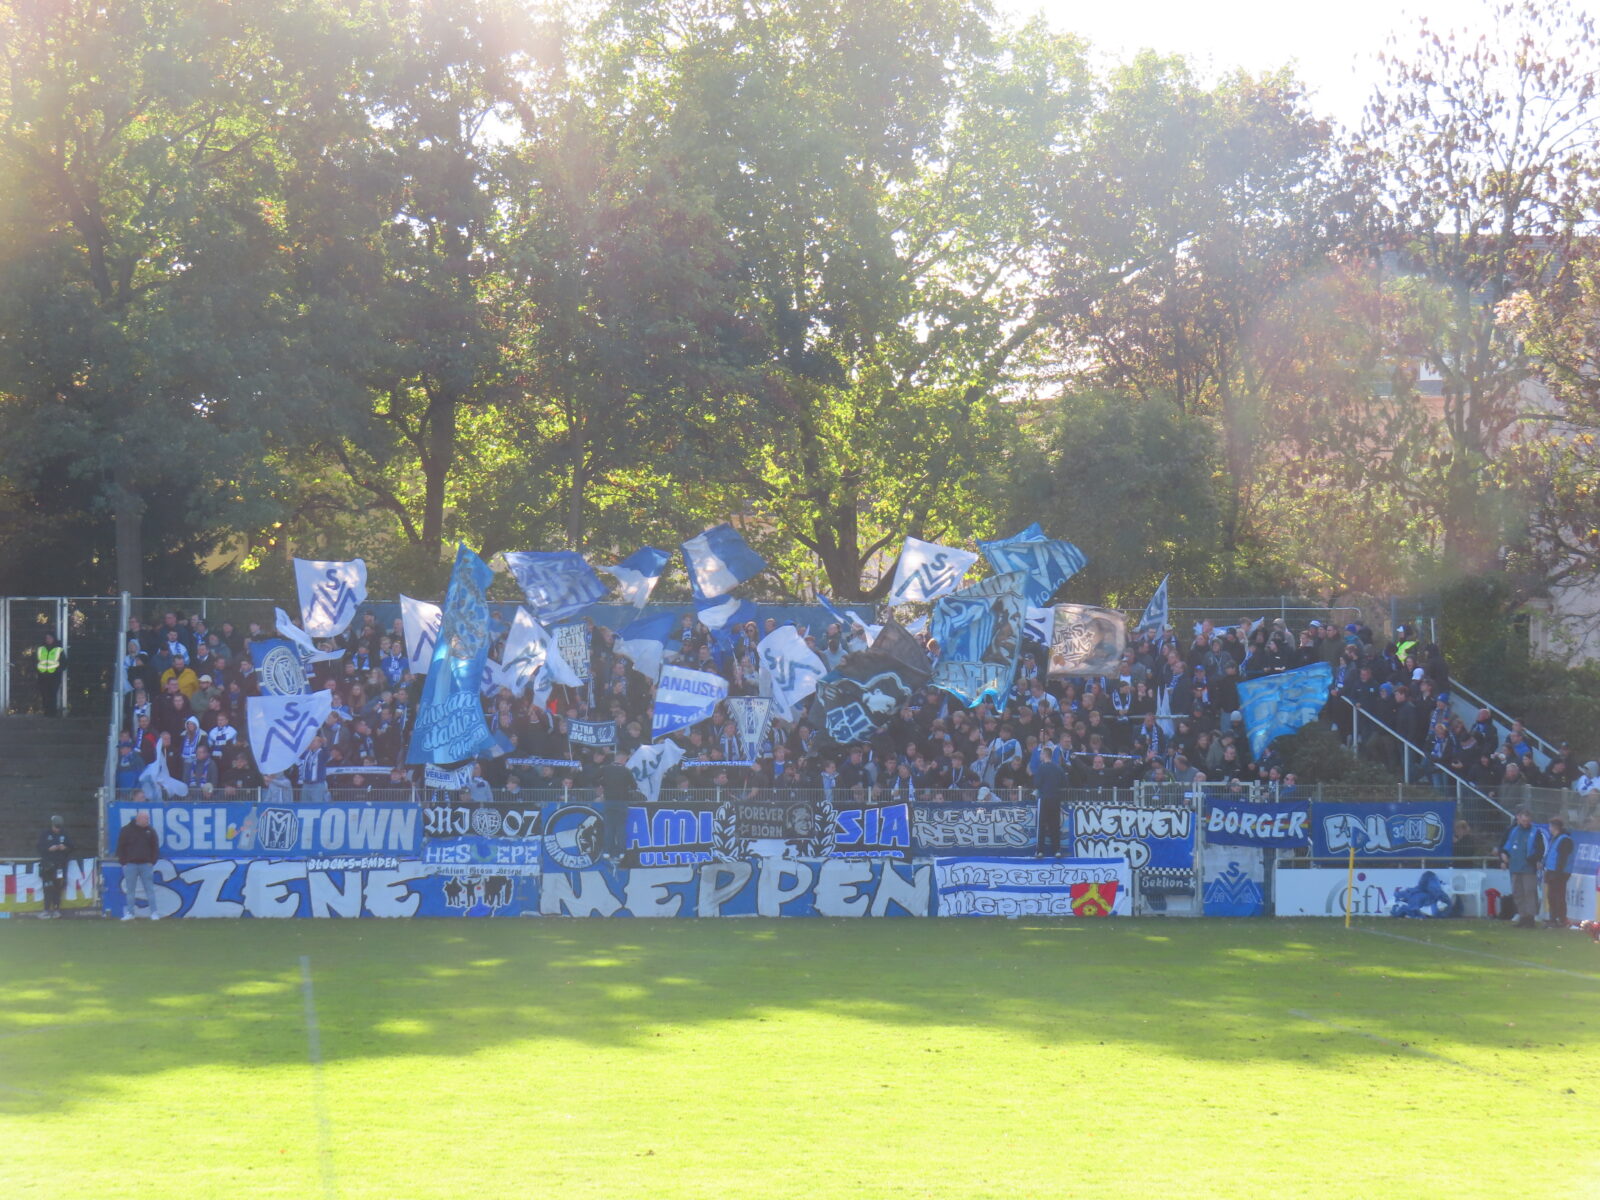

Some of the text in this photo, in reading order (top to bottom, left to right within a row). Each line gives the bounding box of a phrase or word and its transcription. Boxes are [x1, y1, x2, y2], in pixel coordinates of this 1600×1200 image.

[502, 810, 540, 836] 07
[739, 806, 784, 821] FOREVER
[961, 807, 1027, 824] WHITE
[1075, 806, 1190, 838] MEPPEN
[1208, 806, 1308, 839] BÖRGER
[297, 808, 418, 851] TOWN
[912, 823, 1030, 848] REBELS
[121, 859, 931, 918] SZENE MEPPEN
[940, 863, 1120, 888] Imperium
